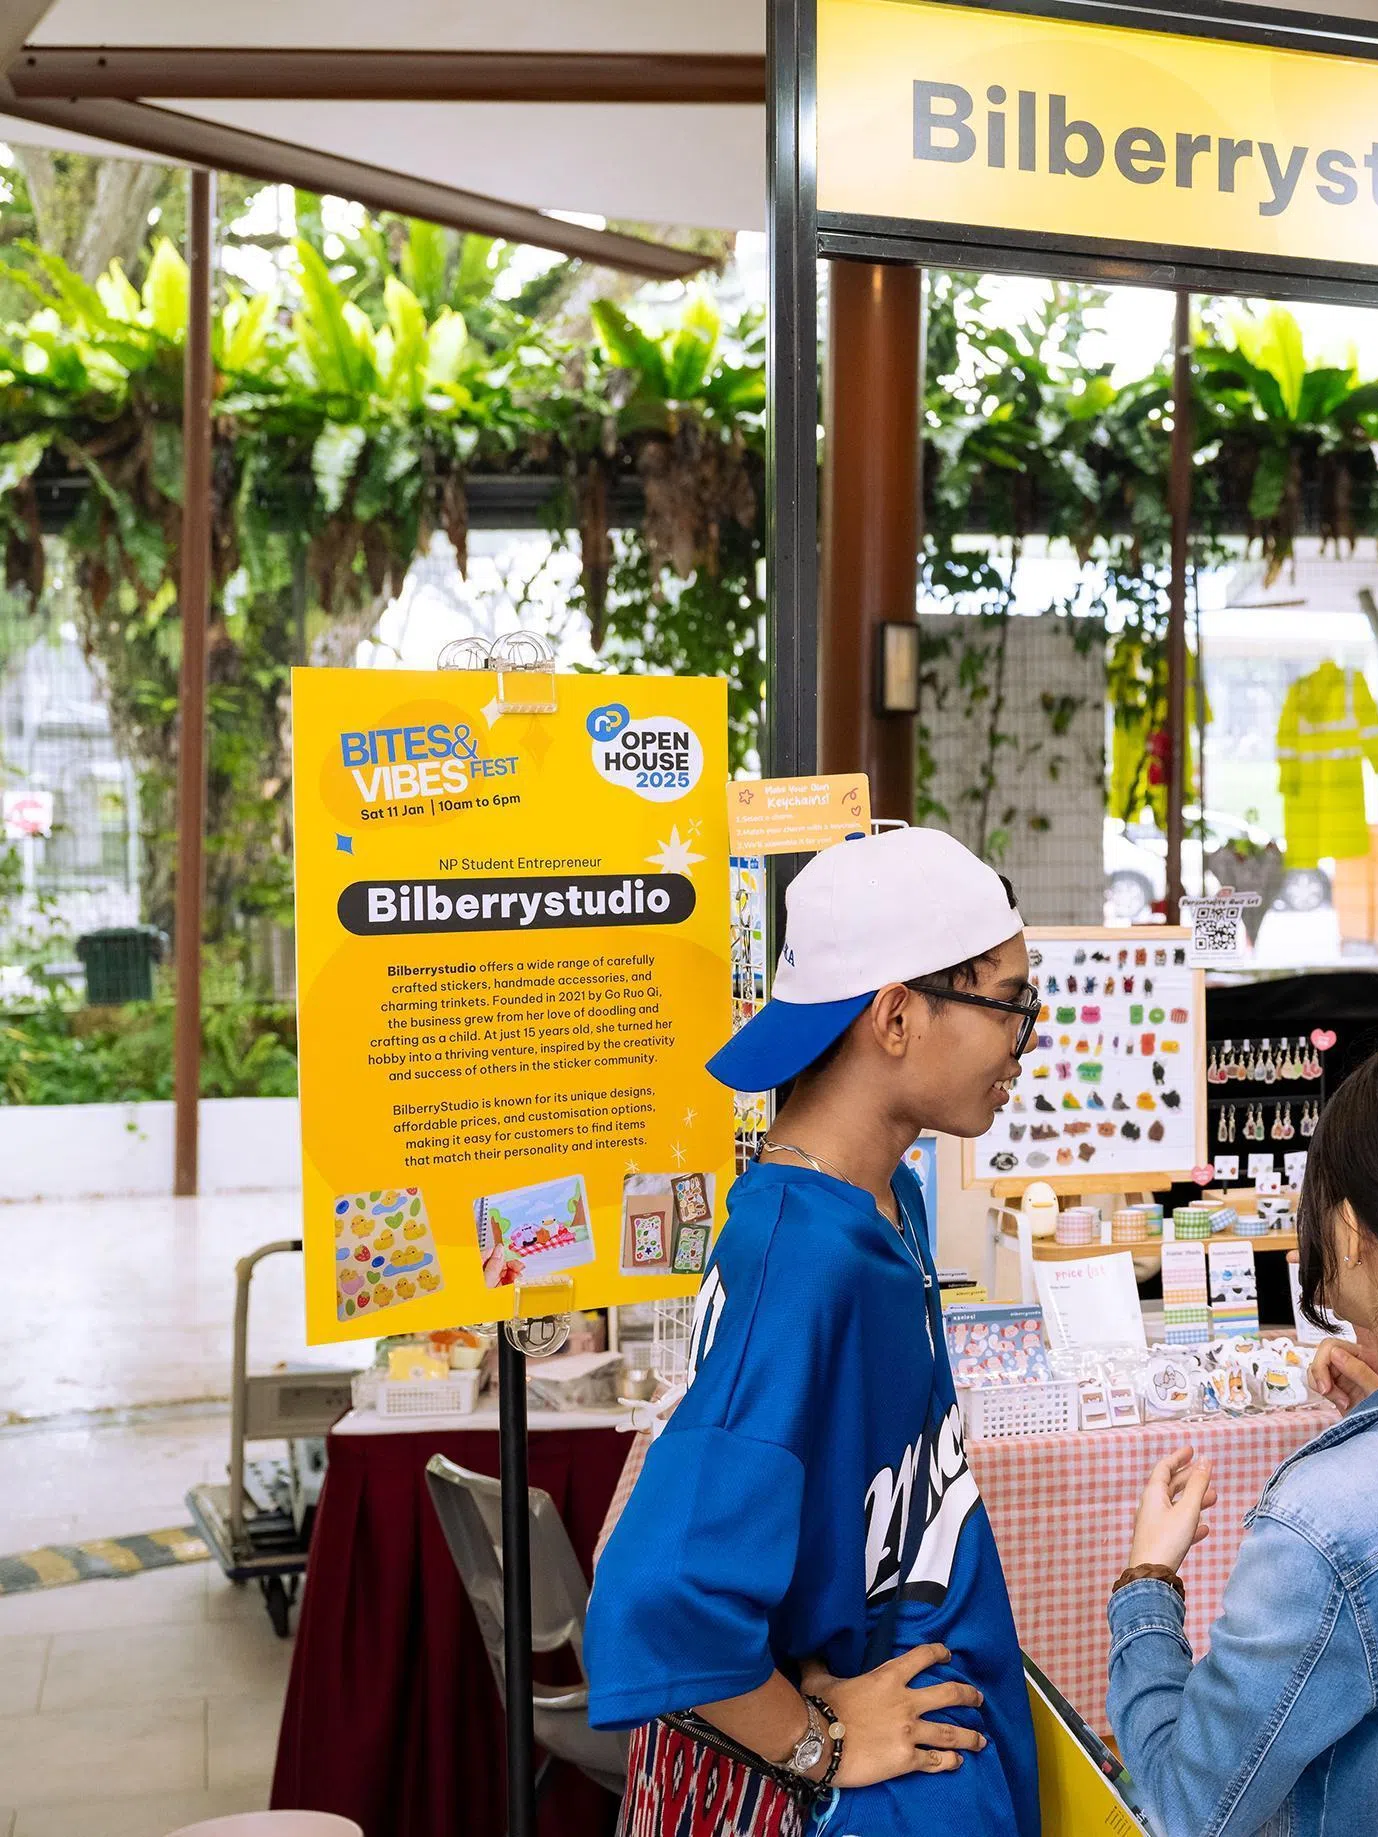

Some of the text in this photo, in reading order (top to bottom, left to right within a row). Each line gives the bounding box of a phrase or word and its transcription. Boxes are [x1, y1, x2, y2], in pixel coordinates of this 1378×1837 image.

[621, 731, 689, 750] OPEN
[604, 752, 689, 771] HOUSE
[351, 756, 519, 803] VIBES FEST
[636, 772, 690, 788] 2025
[361, 794, 521, 821] Sat 11 Jan 10am to 6pm
[439, 856, 602, 870] NP Student Entrepreneur
[367, 879, 671, 926] Bilberrystudio
[388, 962, 476, 976] Bilberrystudio
[479, 961, 513, 972] offers
[527, 959, 554, 969] wide
[557, 960, 589, 970] range
[593, 956, 603, 966] of
[607, 954, 654, 966] carefully
[392, 970, 651, 993] crafted stickers, handmade accessories, and
[381, 987, 661, 1011] charming trinkets. Founded in 2021 by Go Ruo Qi,
[388, 1003, 658, 1028] the business grew from her love of doodling and
[370, 1035, 418, 1047] crafting
[422, 1036, 435, 1044] as
[449, 1030, 480, 1042] child.
[484, 1030, 497, 1040] At
[499, 1029, 520, 1041] just
[524, 1027, 535, 1037] 15
[539, 1027, 569, 1039] years
[572, 1024, 593, 1034] old,
[596, 1023, 614, 1033] she
[617, 1020, 652, 1031] turned
[655, 1019, 672, 1029] her
[368, 1053, 405, 1065] hobby
[409, 1052, 431, 1062] into
[445, 1048, 488, 1059] thriving
[491, 1046, 537, 1056] venture,
[541, 1040, 584, 1054] inspired
[587, 1040, 600, 1052] by
[603, 1039, 620, 1049] the
[623, 1036, 674, 1047] creativity
[389, 1054, 657, 1080] and success of others in the sticker community.
[393, 1088, 655, 1115] BilberryStudio is known for its unique designs,
[393, 1104, 655, 1132] affordable prices, and customisation options,
[406, 1121, 645, 1149] making it easy for customers to find items
[405, 1137, 646, 1166] that match their personality and interests.
[1055, 1268, 1083, 1281] price
